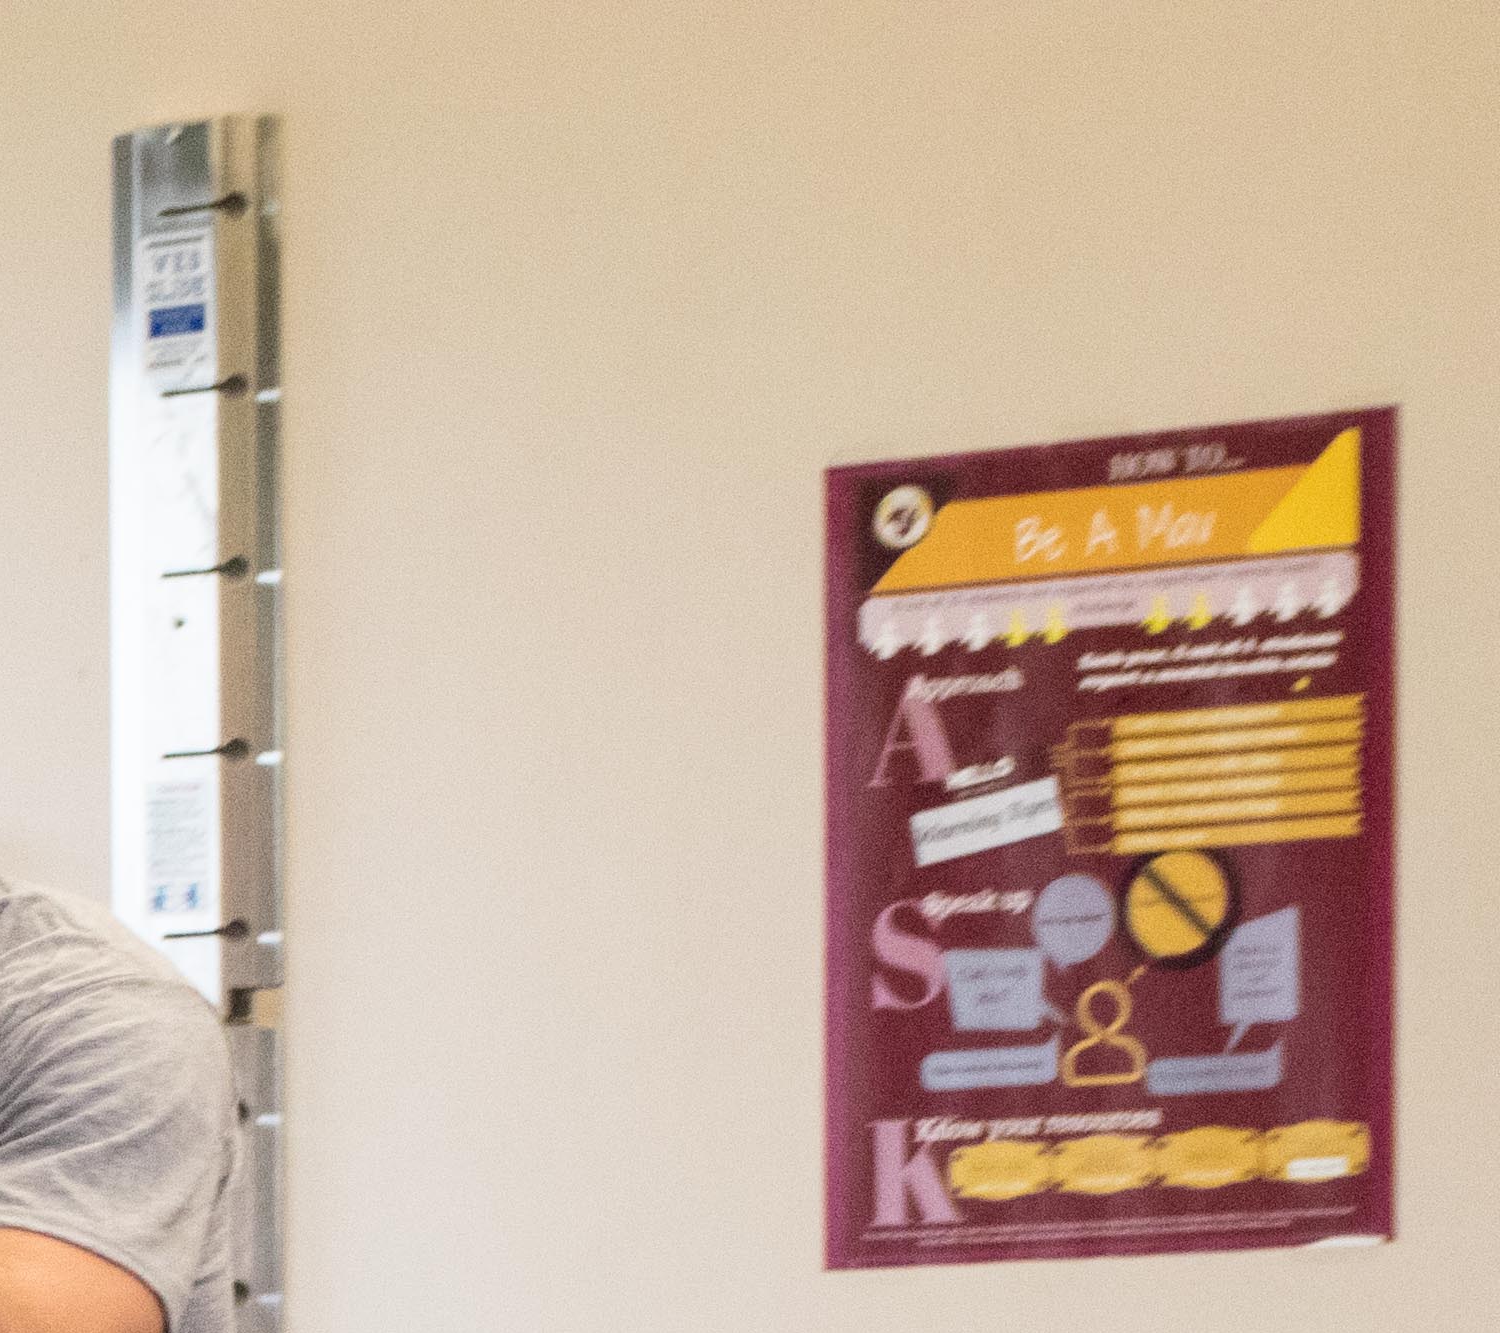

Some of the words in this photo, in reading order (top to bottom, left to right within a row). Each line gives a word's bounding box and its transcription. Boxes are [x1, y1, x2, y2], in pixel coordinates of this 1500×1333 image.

[1085, 509, 1121, 556] A
[871, 901, 946, 1011] S
[868, 1118, 964, 1226] K
